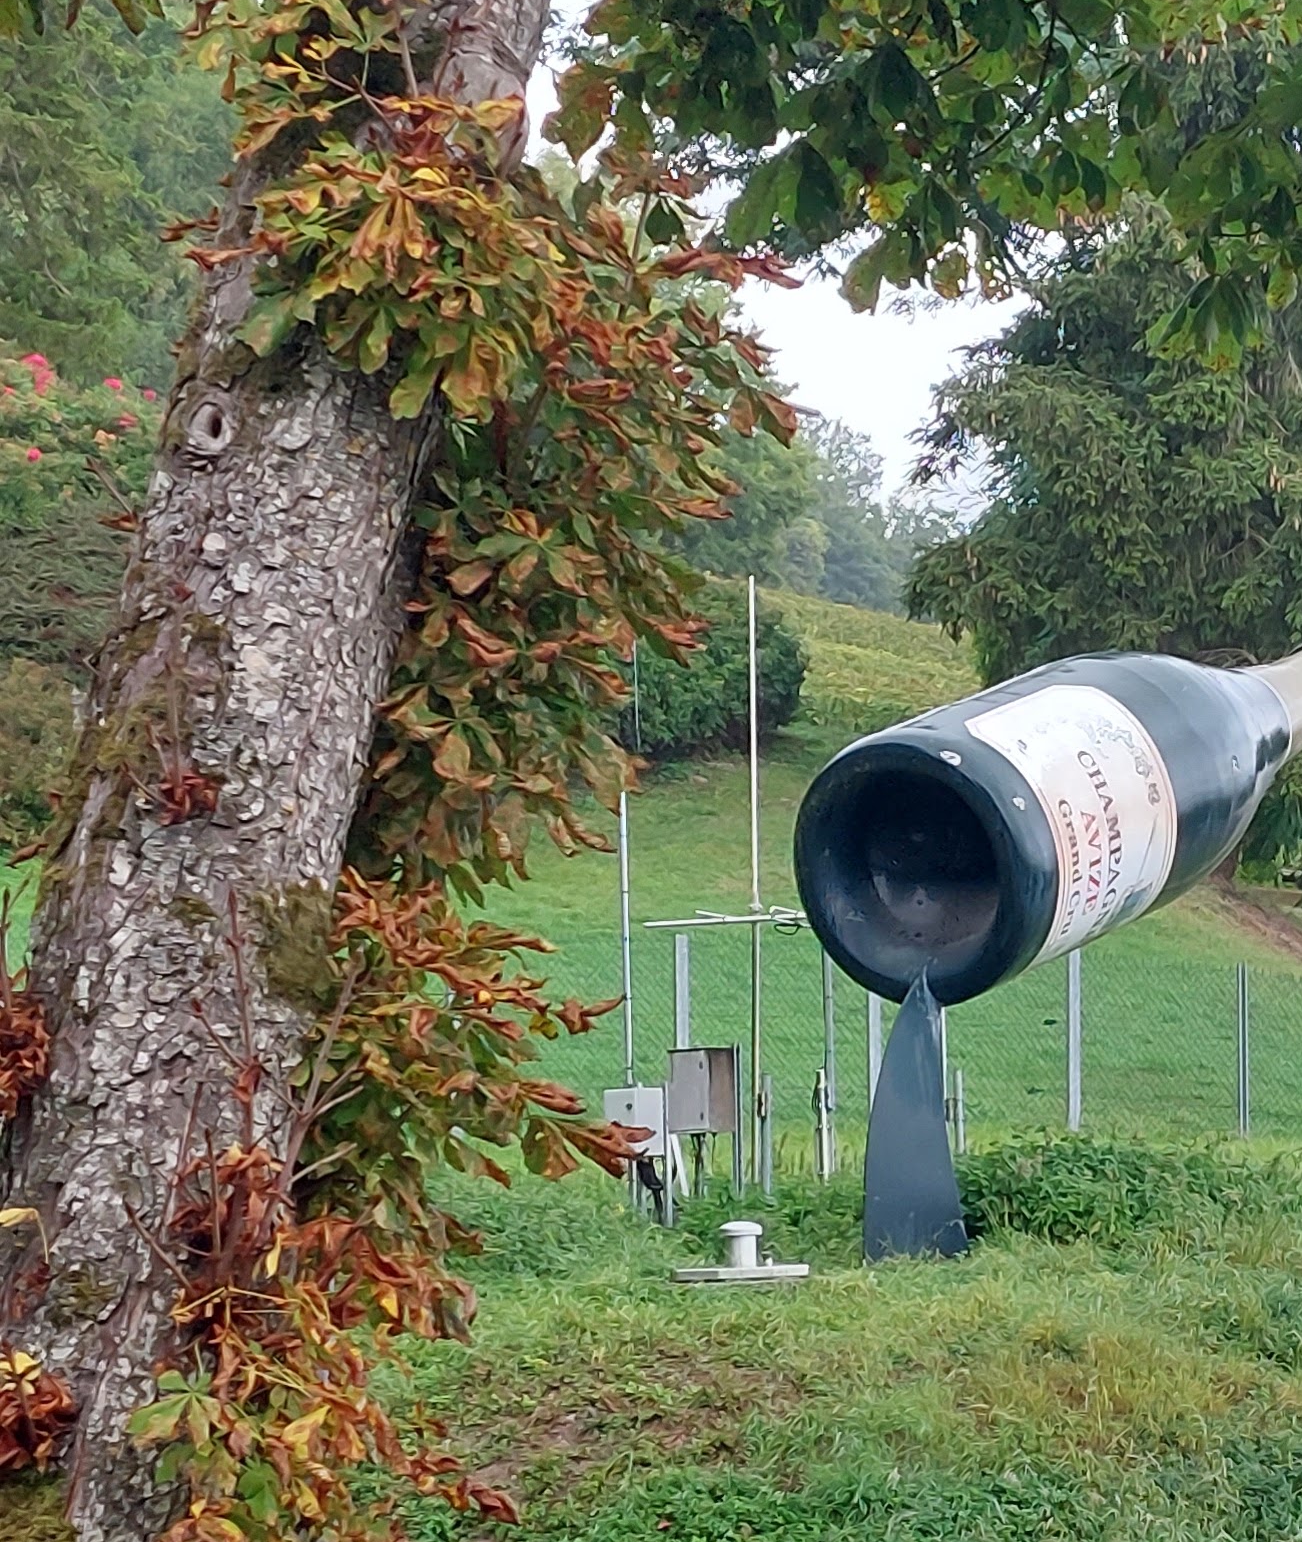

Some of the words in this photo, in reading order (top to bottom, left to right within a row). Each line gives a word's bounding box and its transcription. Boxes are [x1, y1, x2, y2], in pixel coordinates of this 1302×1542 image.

[1058, 799, 1083, 884] Grand
[1080, 811, 1102, 916] AVIZE
[1060, 890, 1081, 936] Cru
